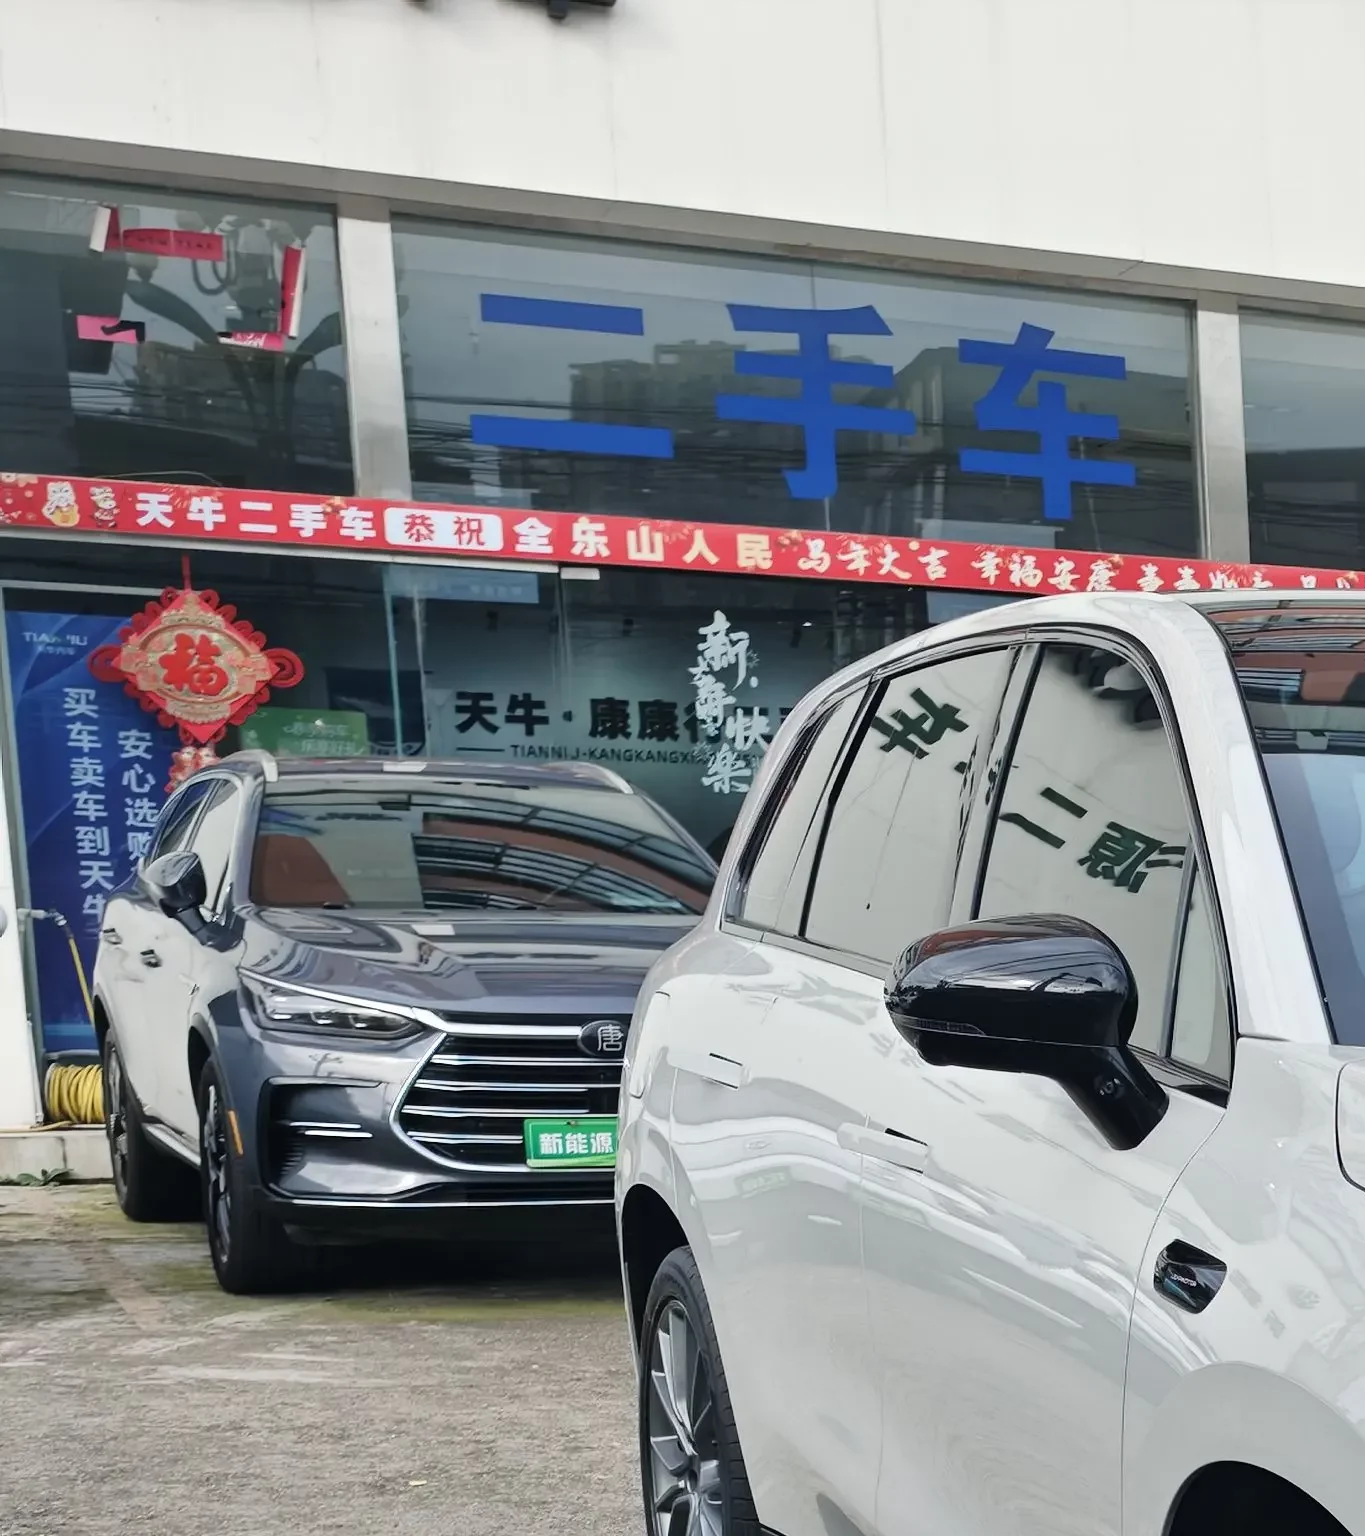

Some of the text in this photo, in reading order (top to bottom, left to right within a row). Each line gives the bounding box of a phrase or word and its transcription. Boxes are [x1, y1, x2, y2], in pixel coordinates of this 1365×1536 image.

[469, 293, 1137, 520] 二手车
[135, 491, 377, 542] 天牛二手车
[404, 512, 486, 547] 恭祝
[158, 632, 229, 697] 福
[62, 686, 115, 921] 买车卖车到天牛
[597, 1023, 624, 1052] 唐
[539, 1131, 613, 1155] 新能源
